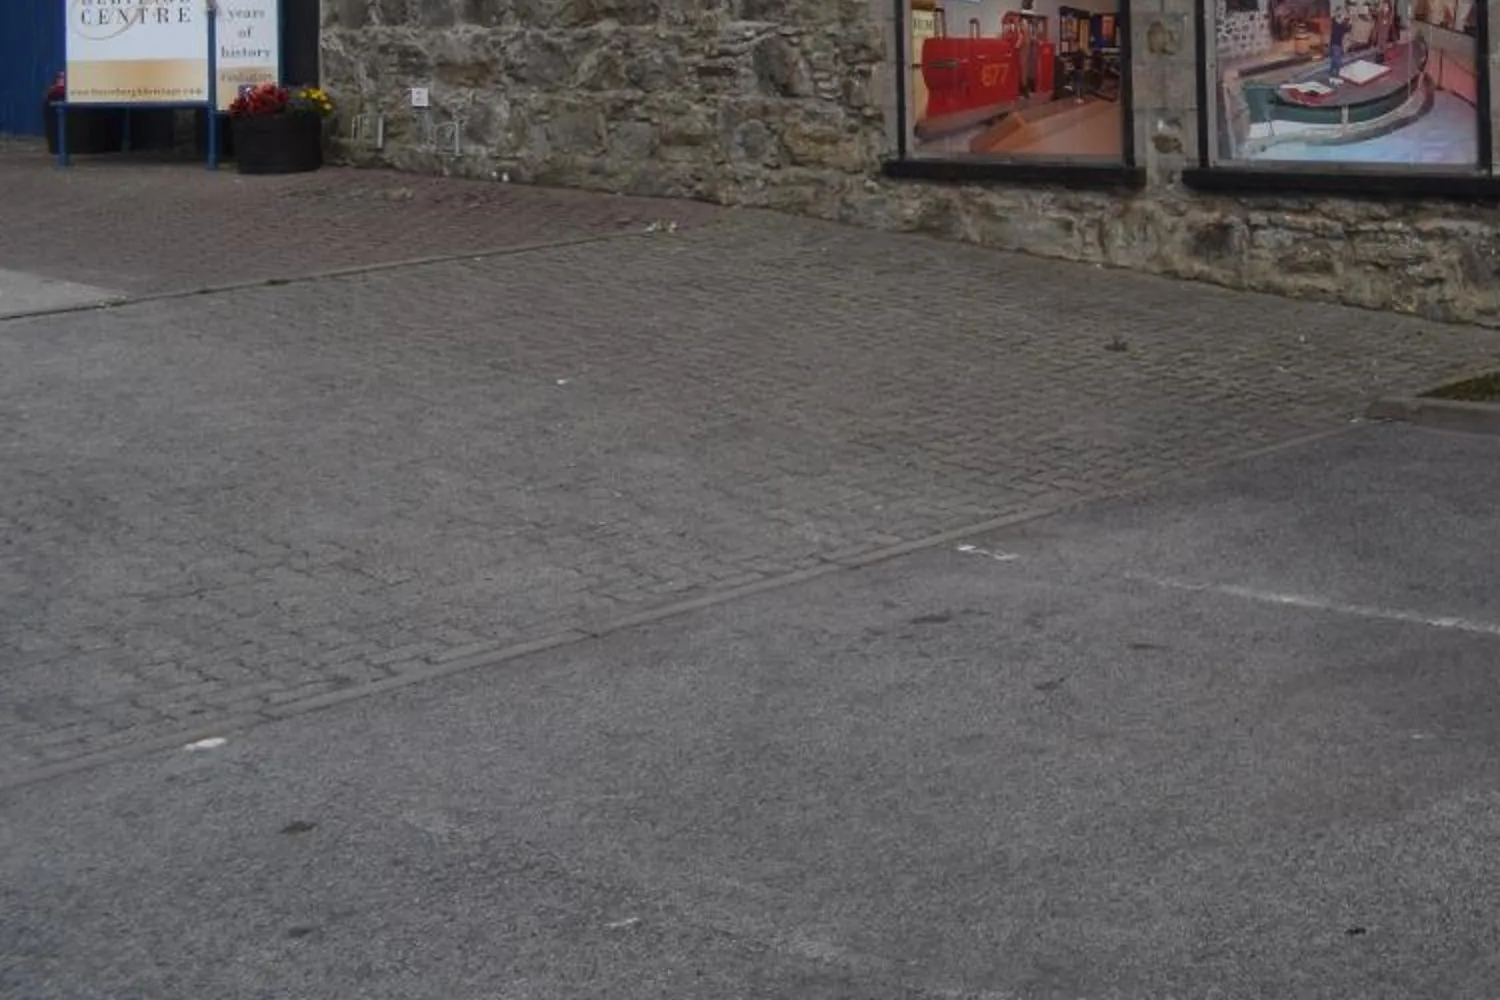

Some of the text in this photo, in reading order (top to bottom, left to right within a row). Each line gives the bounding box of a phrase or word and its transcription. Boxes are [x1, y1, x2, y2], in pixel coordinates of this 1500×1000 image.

[81, 7, 191, 25] CENTRE
[227, 8, 266, 22] years
[238, 26, 254, 38] of
[221, 45, 272, 60] history
